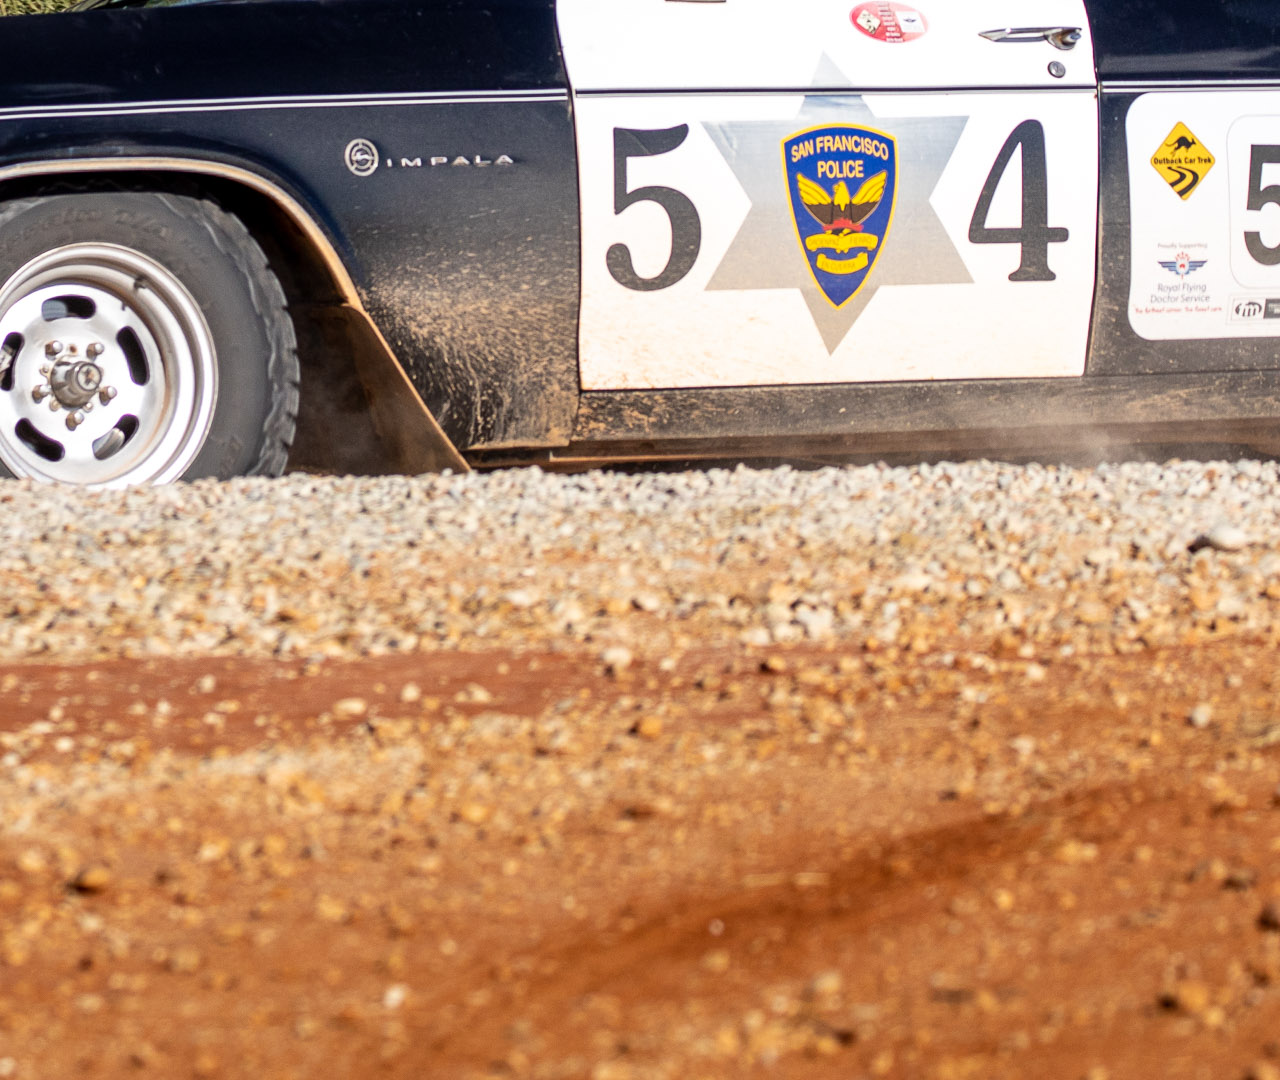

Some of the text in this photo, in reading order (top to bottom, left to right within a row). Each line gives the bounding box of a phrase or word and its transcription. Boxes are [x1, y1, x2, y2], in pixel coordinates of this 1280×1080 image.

[791, 135, 889, 162] SAN FRANCISCO
[386, 154, 514, 168] IMPALA
[1154, 156, 1212, 165] Outback Car Trek
[817, 160, 864, 179] POLICE
[606, 123, 702, 292] 5
[968, 118, 1070, 282] 4
[1157, 282, 1207, 293] Royal Flying
[1150, 293, 1211, 304] Doctor Service
